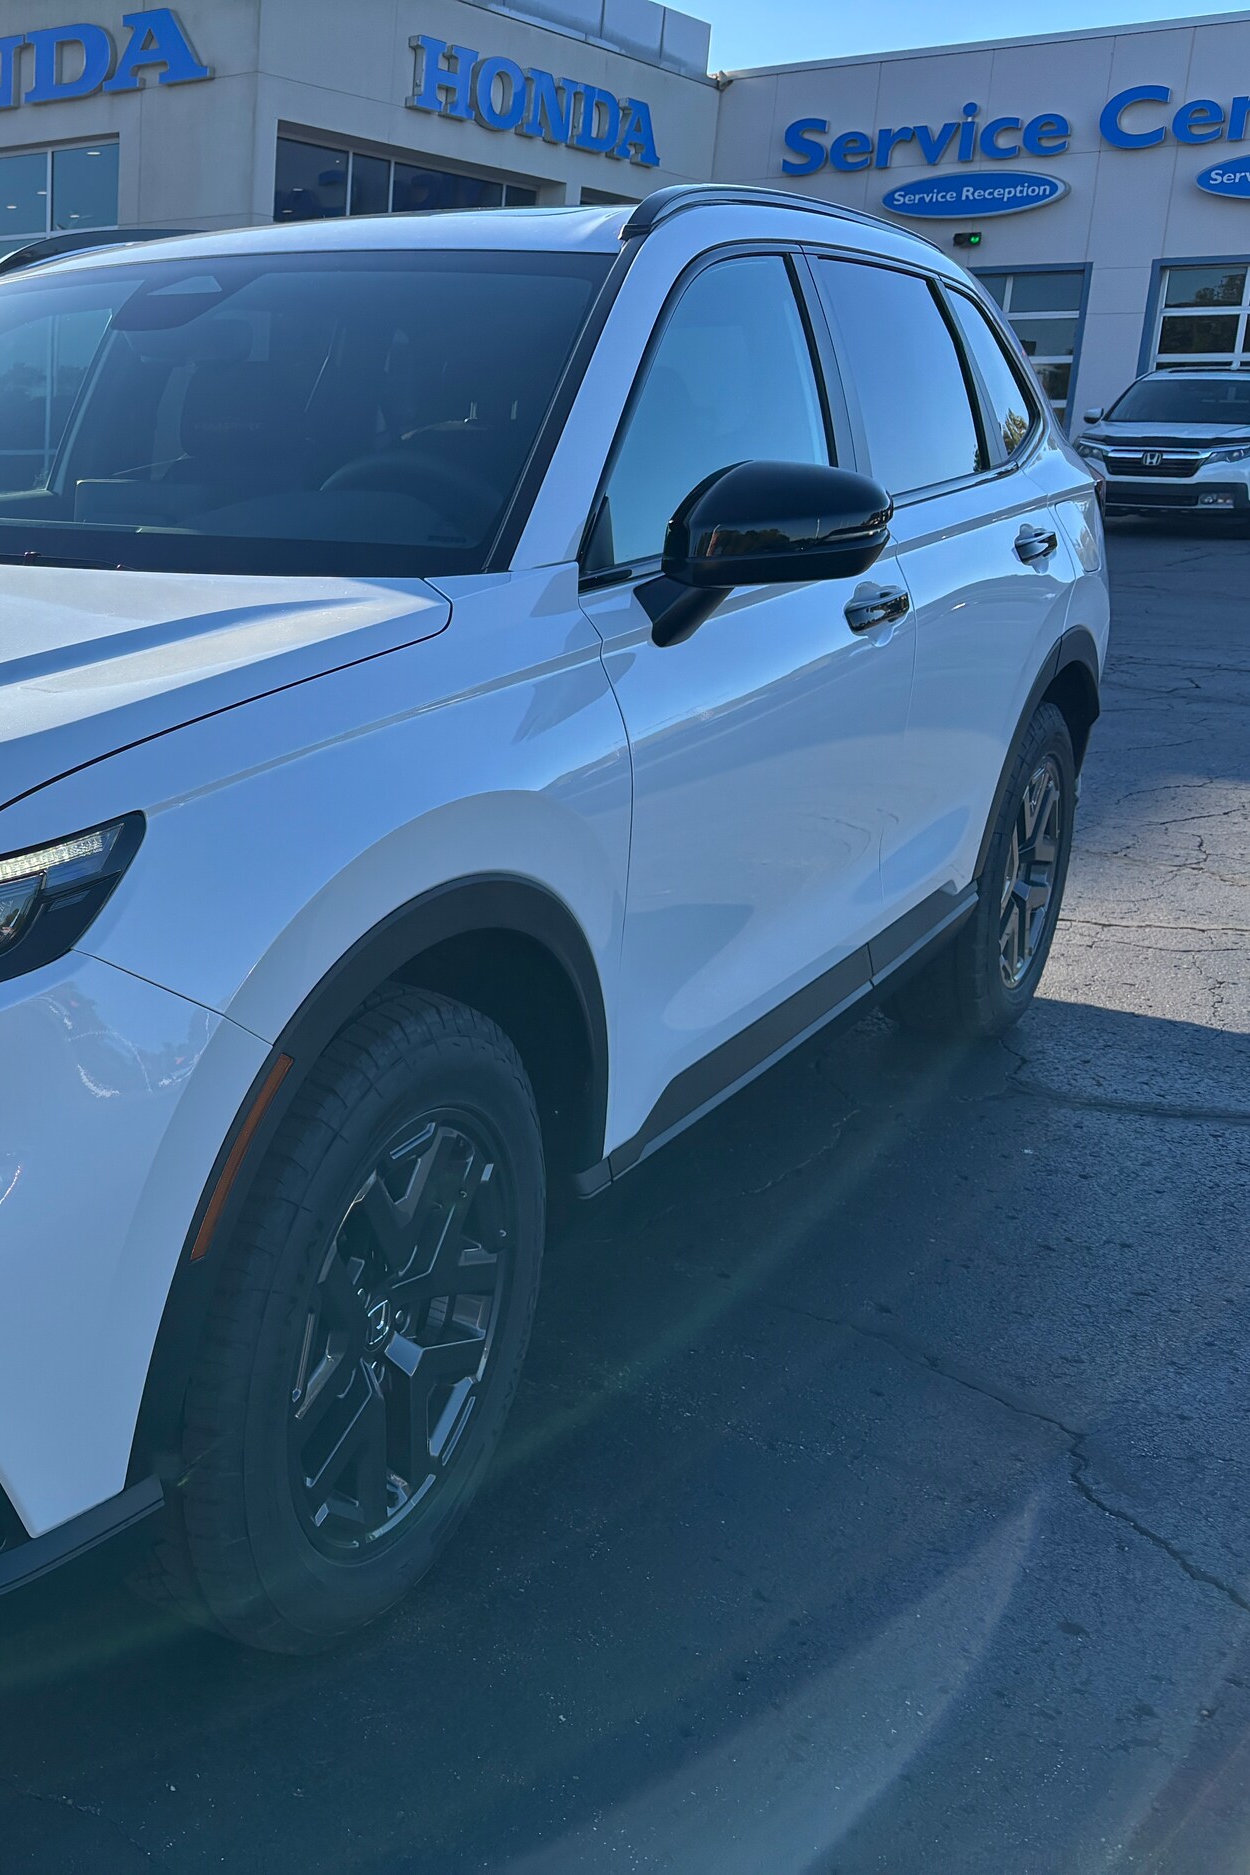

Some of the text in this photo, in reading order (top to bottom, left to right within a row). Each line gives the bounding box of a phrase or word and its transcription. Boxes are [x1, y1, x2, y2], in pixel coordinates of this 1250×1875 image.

[405, 34, 660, 167] HONDA
[781, 101, 1071, 176] Service
[893, 182, 1050, 205] Service Reception
